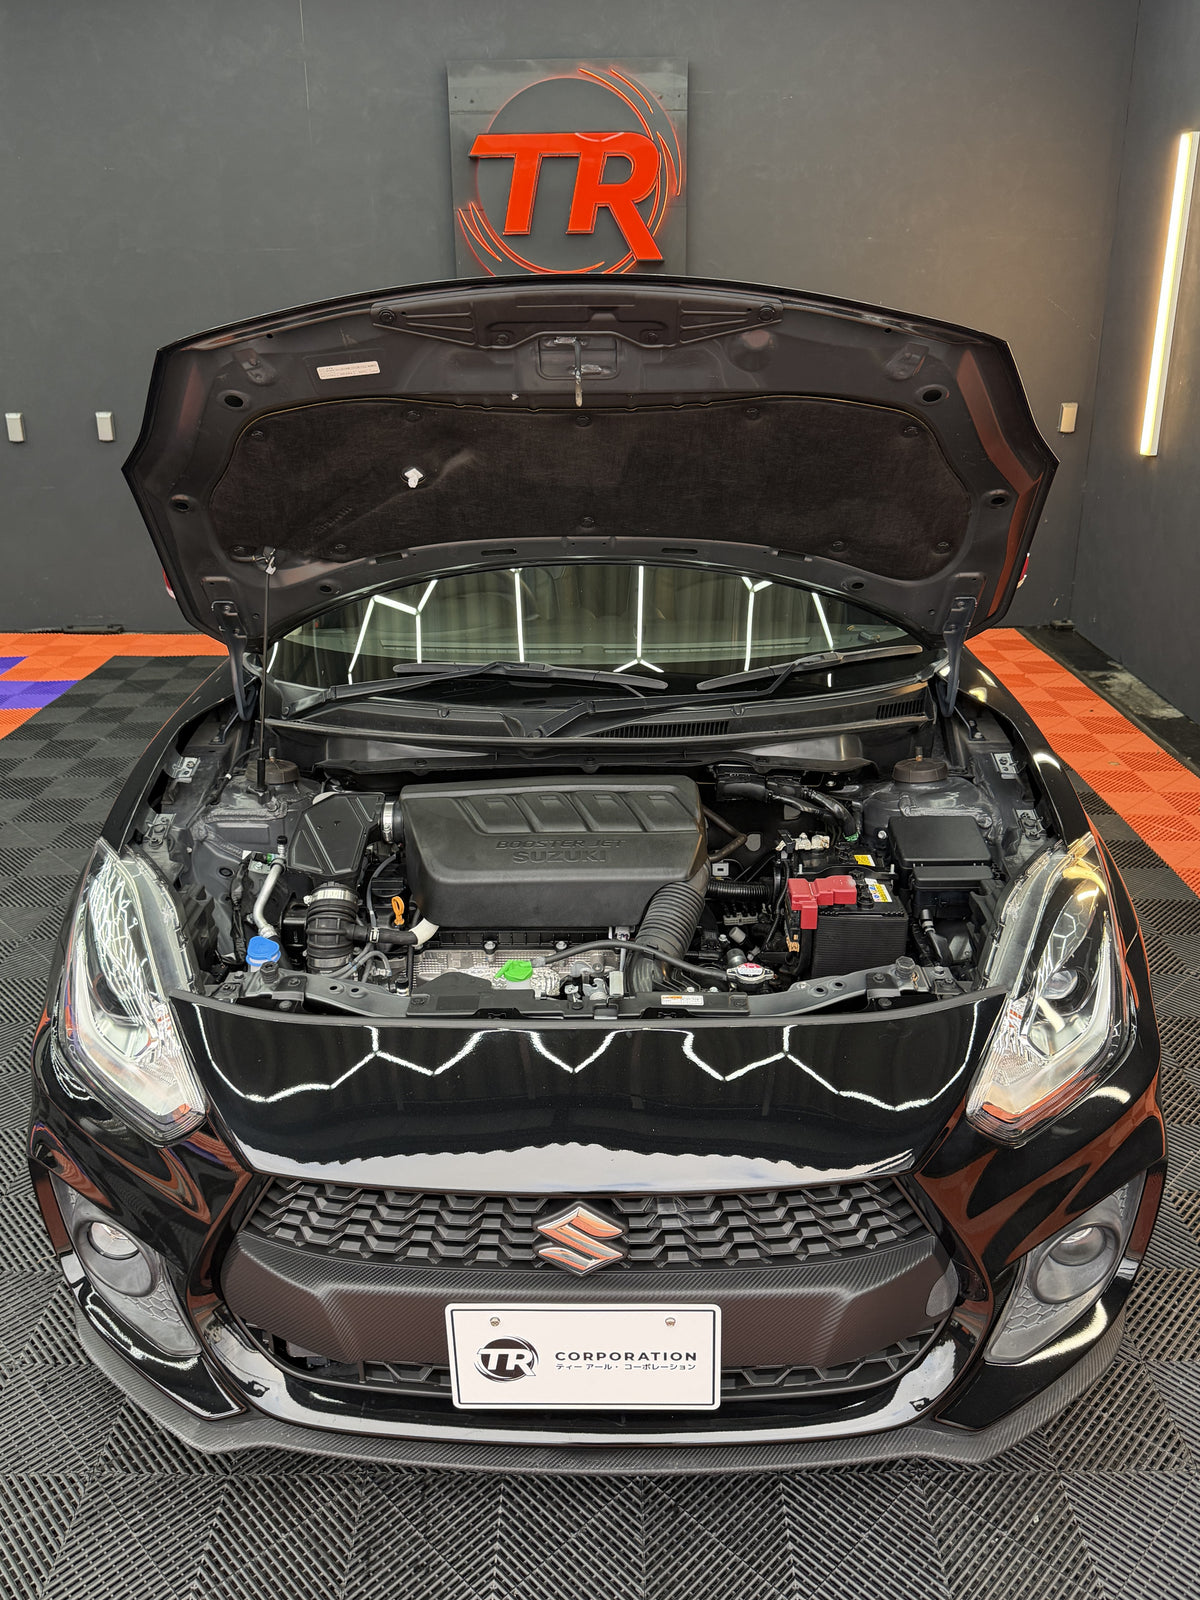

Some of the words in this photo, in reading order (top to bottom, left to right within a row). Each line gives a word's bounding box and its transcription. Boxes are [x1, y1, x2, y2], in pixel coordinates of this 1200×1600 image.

[469, 132, 663, 261] TR
[512, 851, 607, 863] SUZUKI
[477, 1348, 536, 1376] TR
[555, 1352, 697, 1361] CORPORATION
